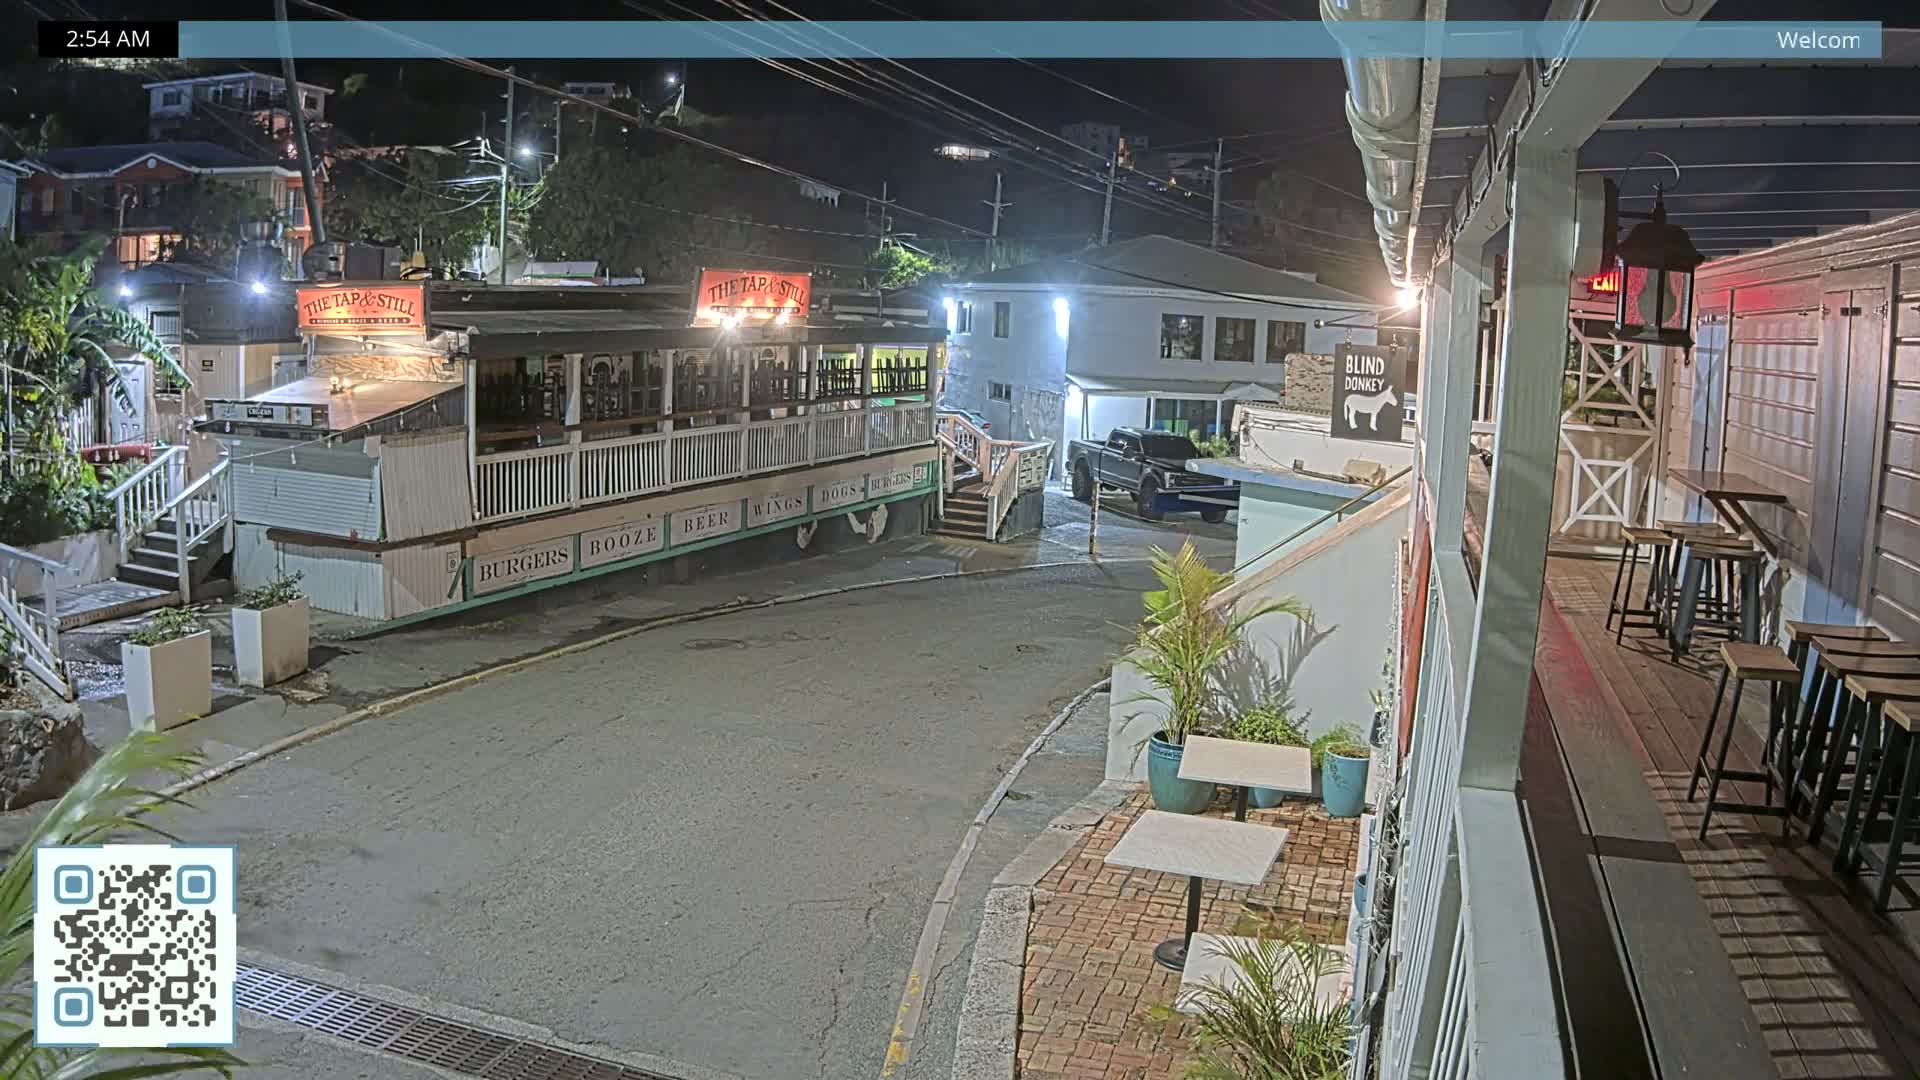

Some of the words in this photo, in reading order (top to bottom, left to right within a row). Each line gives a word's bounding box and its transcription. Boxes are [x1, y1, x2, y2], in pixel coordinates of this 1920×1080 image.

[708, 280, 738, 303] THE
[741, 276, 766, 293] TAP
[778, 279, 804, 306] STILL
[304, 297, 332, 317] THE
[331, 292, 360, 307] TAP
[376, 293, 416, 317] STILL
[1345, 354, 1385, 376] BLIND
[1344, 375, 1385, 392] DONKEY
[871, 471, 912, 491] BURGERS
[822, 484, 857, 502] DOGS
[753, 496, 803, 517] WINGS
[683, 511, 729, 534] BEER
[589, 527, 657, 557] BOOZE
[479, 547, 569, 583] BURGERS
